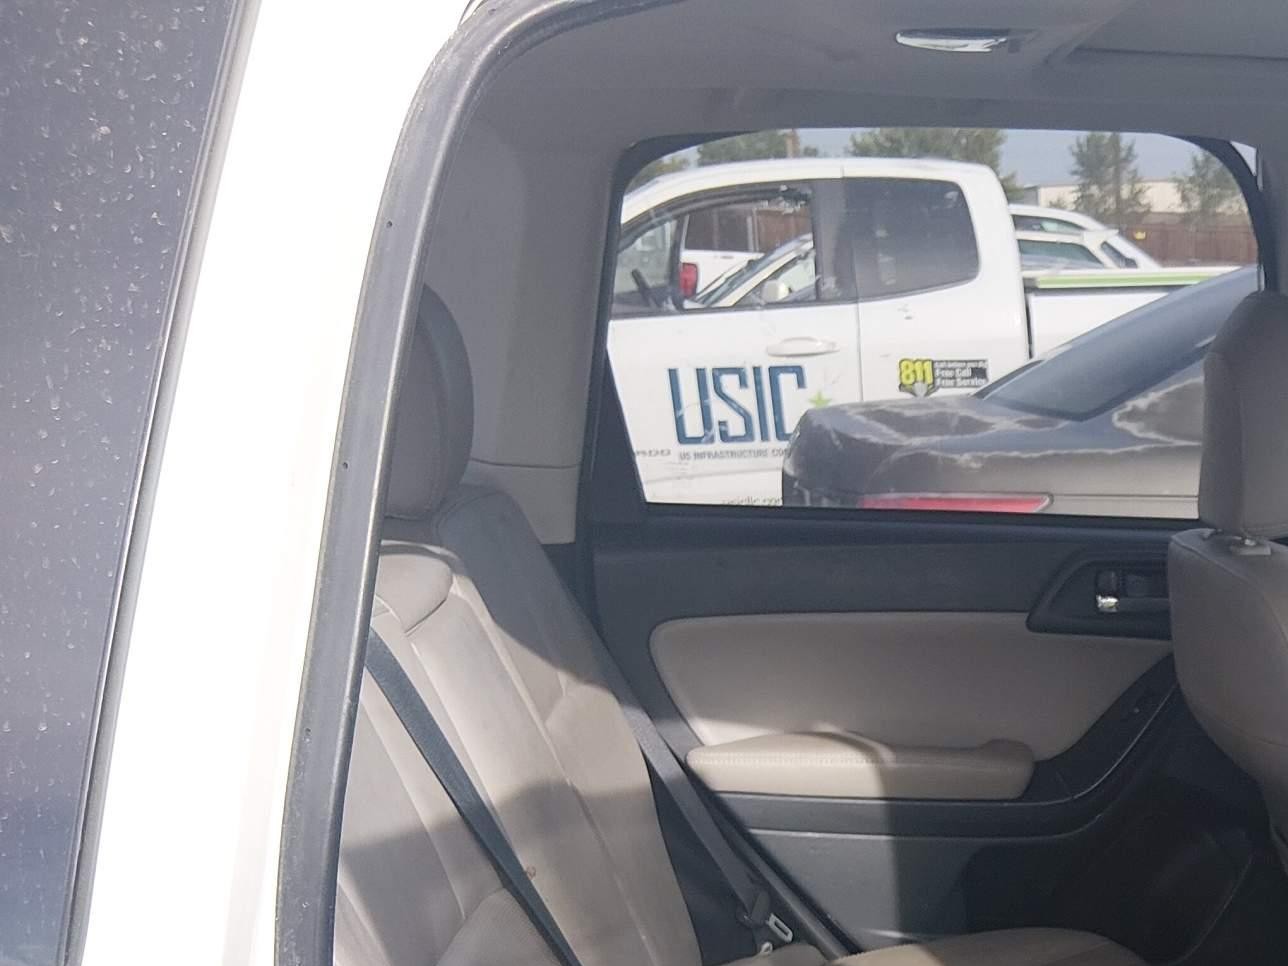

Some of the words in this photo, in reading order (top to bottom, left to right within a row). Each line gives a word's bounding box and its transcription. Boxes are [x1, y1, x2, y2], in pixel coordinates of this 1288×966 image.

[900, 359, 934, 385] 811
[668, 365, 807, 445] USIC
[693, 448, 769, 461] INFRASTRUCTURE
